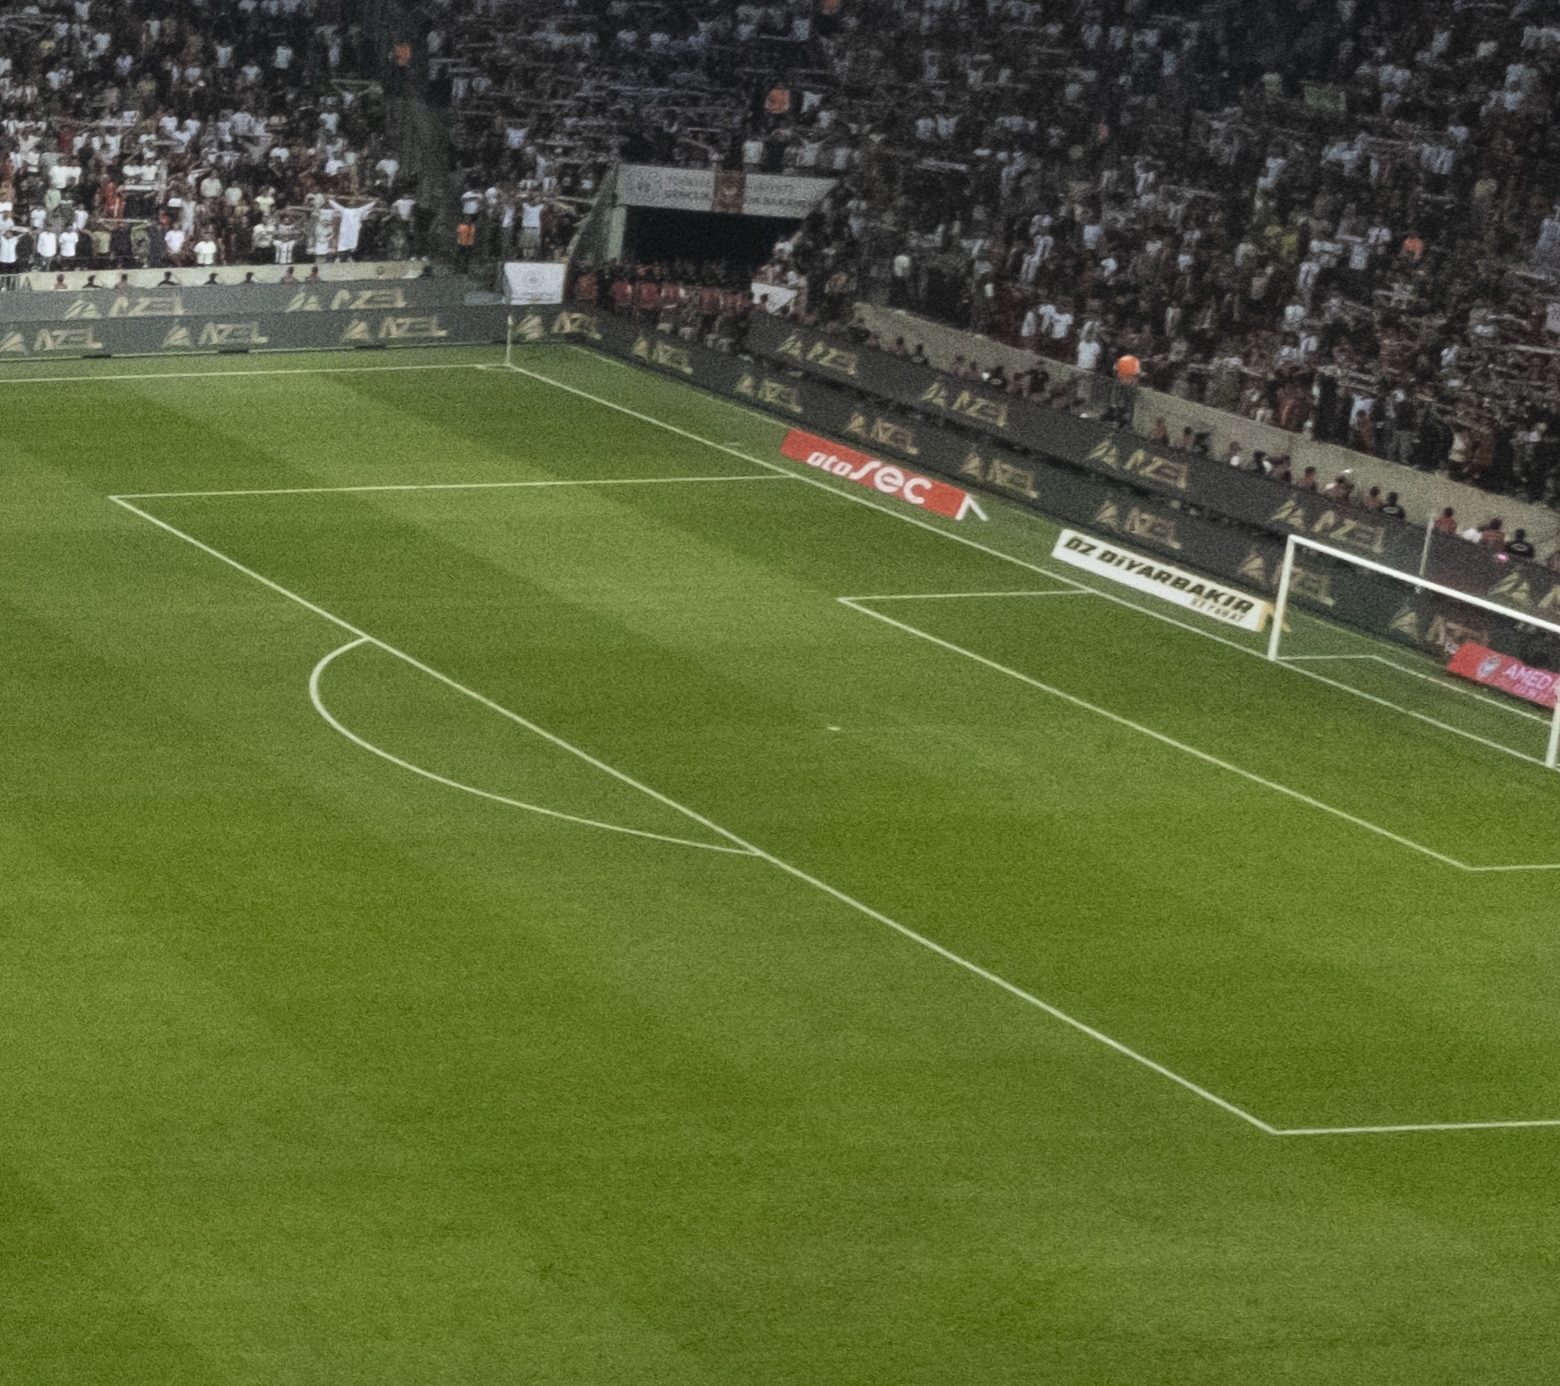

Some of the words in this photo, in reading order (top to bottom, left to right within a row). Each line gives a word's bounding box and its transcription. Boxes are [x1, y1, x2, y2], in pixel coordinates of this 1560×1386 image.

[110, 297, 184, 316] AZEL
[331, 290, 405, 309] AZEL
[200, 323, 268, 344] AZEL
[379, 317, 447, 338] AZEL
[35, 330, 102, 350] AZEL
